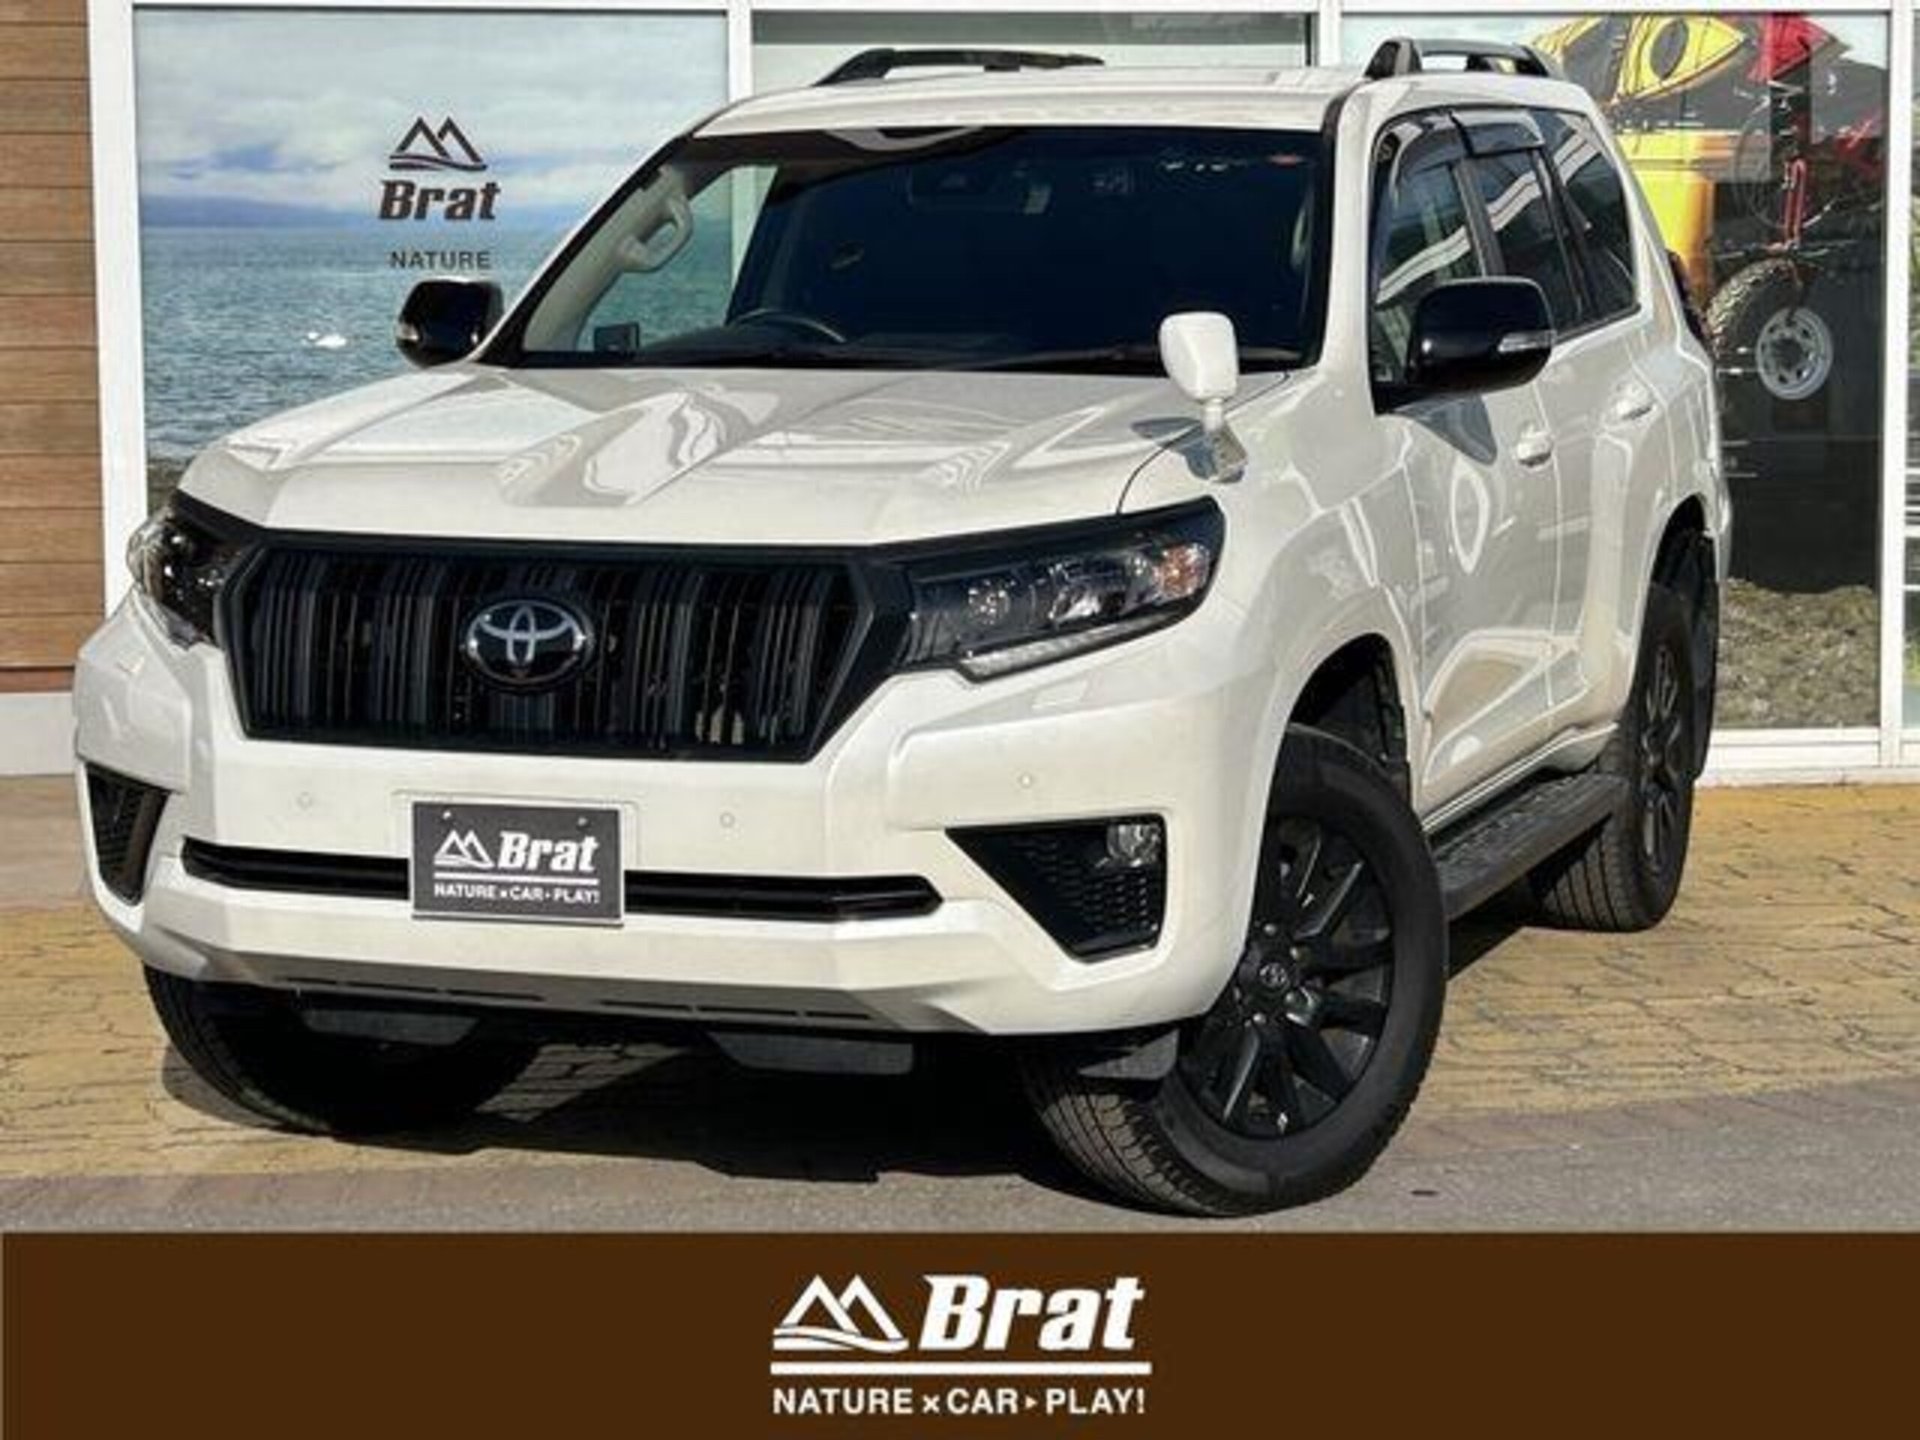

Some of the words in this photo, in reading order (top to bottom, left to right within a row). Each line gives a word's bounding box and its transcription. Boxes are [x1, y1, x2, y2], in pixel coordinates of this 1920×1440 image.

[379, 179, 500, 220] Brat
[390, 251, 492, 269] NATURE
[498, 830, 598, 872] Brat
[434, 883, 496, 899] NATURE
[509, 887, 543, 901] CAR
